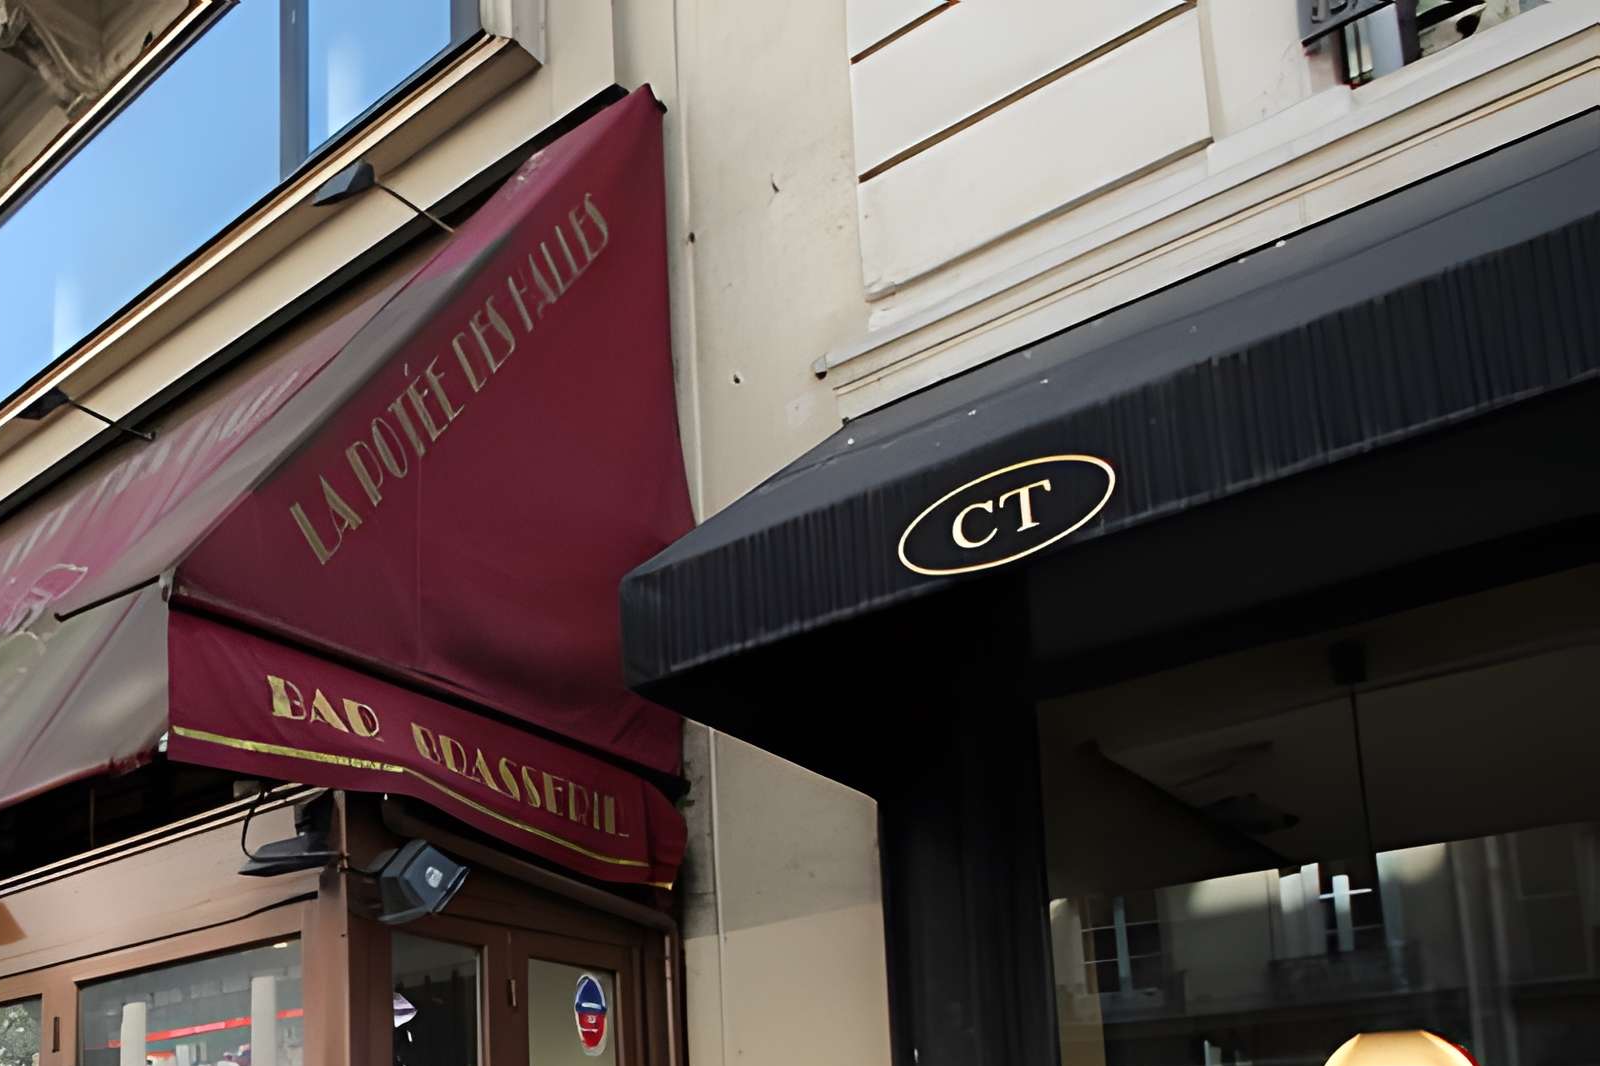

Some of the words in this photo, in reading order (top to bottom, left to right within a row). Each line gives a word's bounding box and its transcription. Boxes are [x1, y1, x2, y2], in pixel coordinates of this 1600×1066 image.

[289, 473, 362, 564] LA
[951, 478, 1052, 549] CT
[266, 674, 385, 743] BAR
